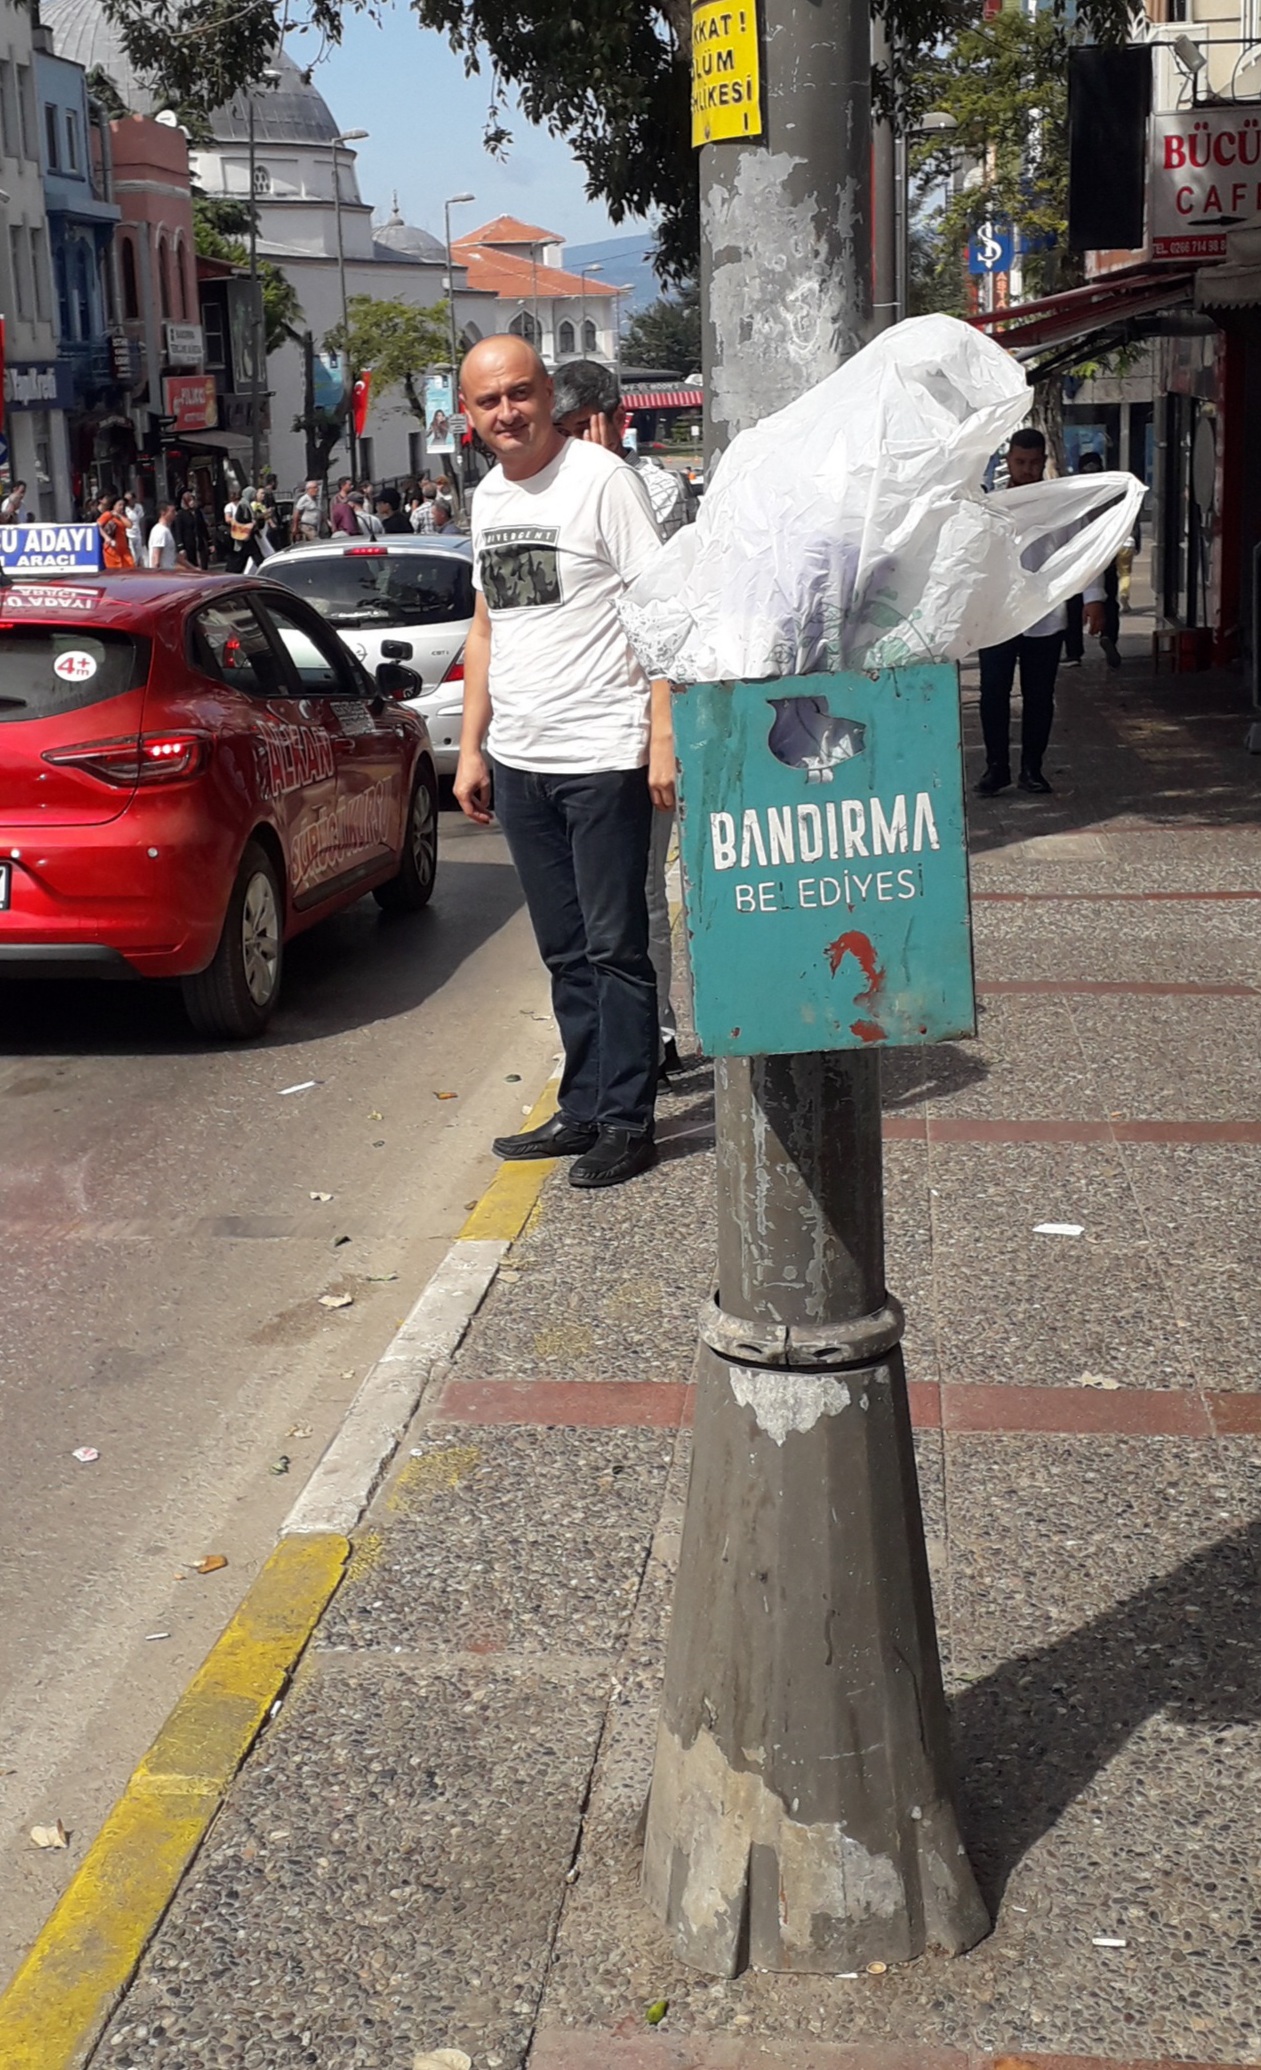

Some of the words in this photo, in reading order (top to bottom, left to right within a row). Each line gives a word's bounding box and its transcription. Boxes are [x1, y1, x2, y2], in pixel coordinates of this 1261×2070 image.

[692, 49, 735, 81] LÜM
[1176, 183, 1261, 215] CAF
[0, 526, 18, 553] Ü
[24, 527, 93, 552] ADAYI
[16, 554, 76, 567] ARACI
[710, 792, 940, 871] BANDIRMA
